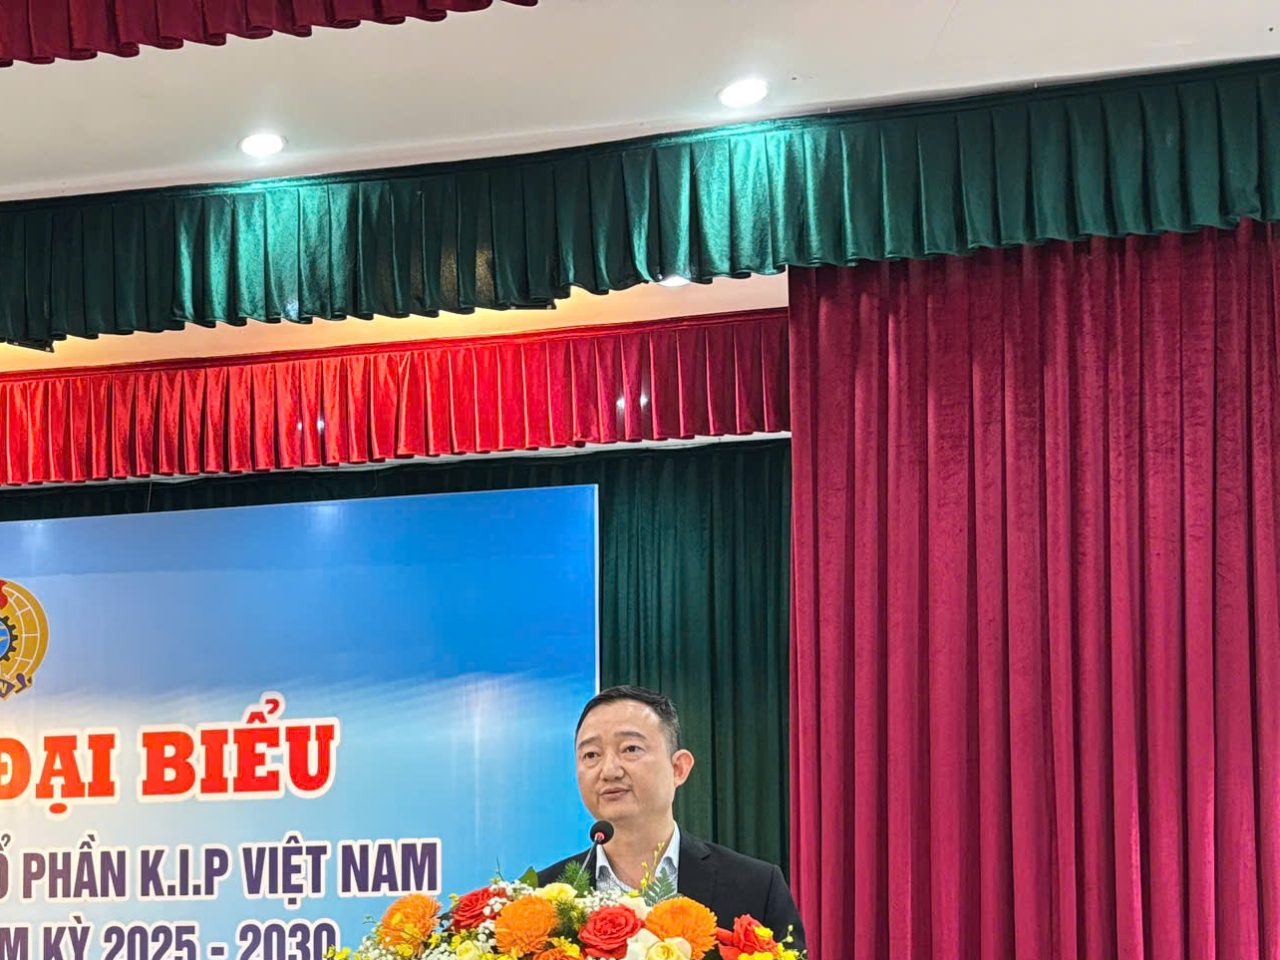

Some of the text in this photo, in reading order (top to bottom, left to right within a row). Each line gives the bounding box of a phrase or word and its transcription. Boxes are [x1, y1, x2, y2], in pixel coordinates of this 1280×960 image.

[142, 698, 335, 796] BIỂU
[22, 834, 126, 899] PHẦN
[140, 848, 229, 897] K.I.P
[242, 835, 327, 905] VIỆT
[341, 842, 438, 892] NAM
